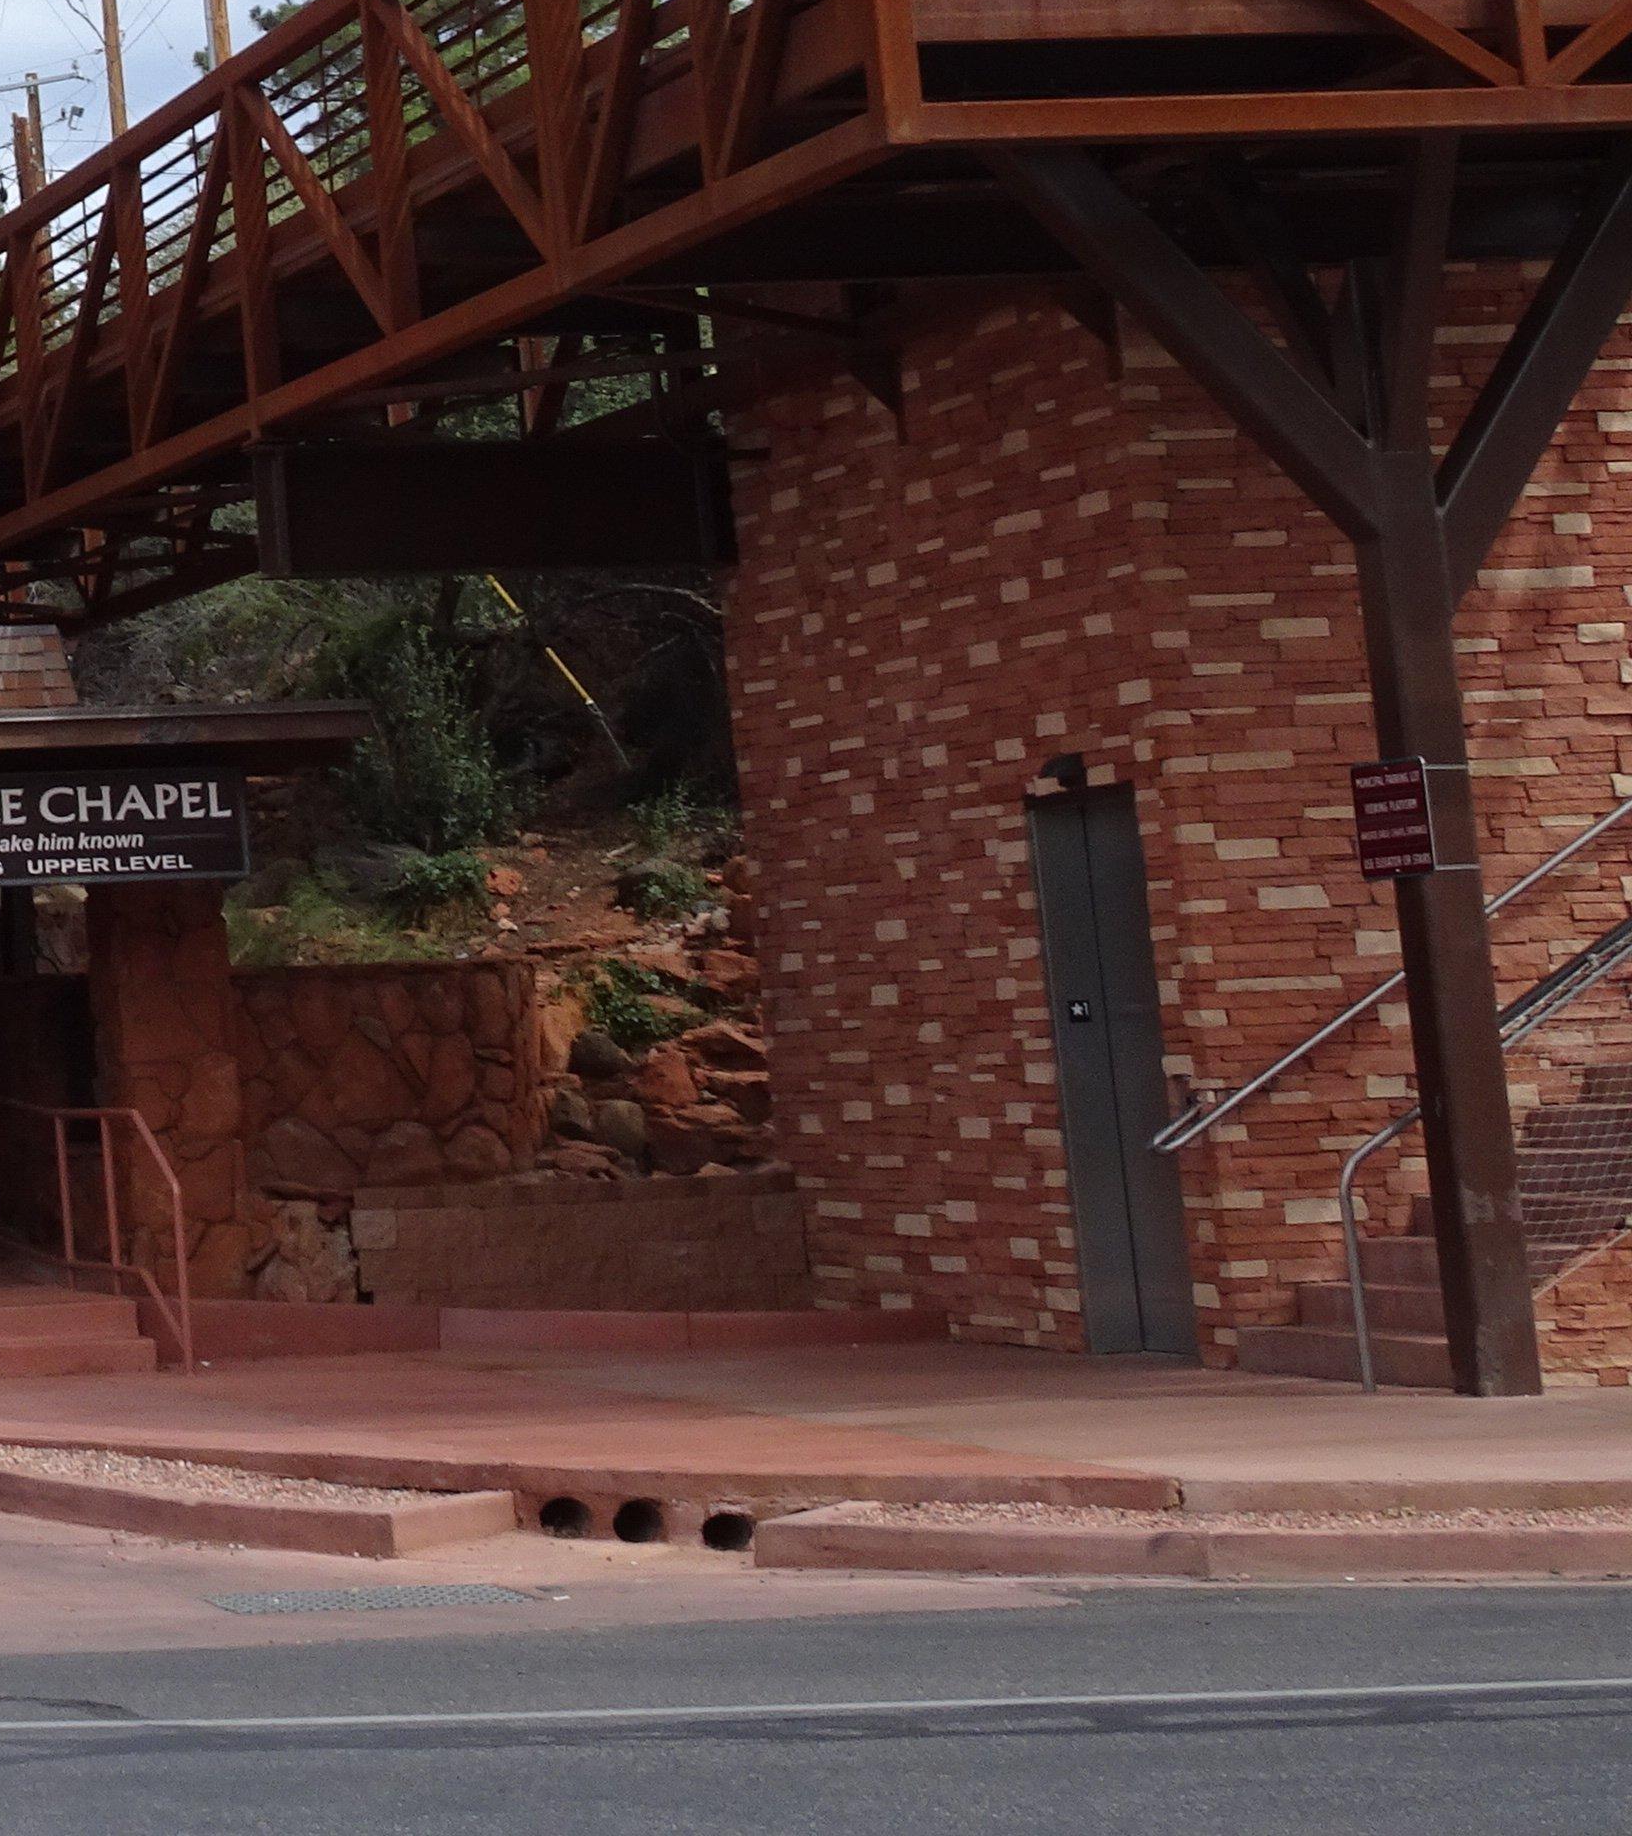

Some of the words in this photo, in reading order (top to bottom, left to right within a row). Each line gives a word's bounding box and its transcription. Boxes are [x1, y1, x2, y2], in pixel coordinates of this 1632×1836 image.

[39, 781, 233, 823] CHAPEL
[37, 832, 75, 852] him
[78, 832, 145, 850] known
[26, 856, 111, 875] UPPER
[115, 854, 194, 872] LEVEL
